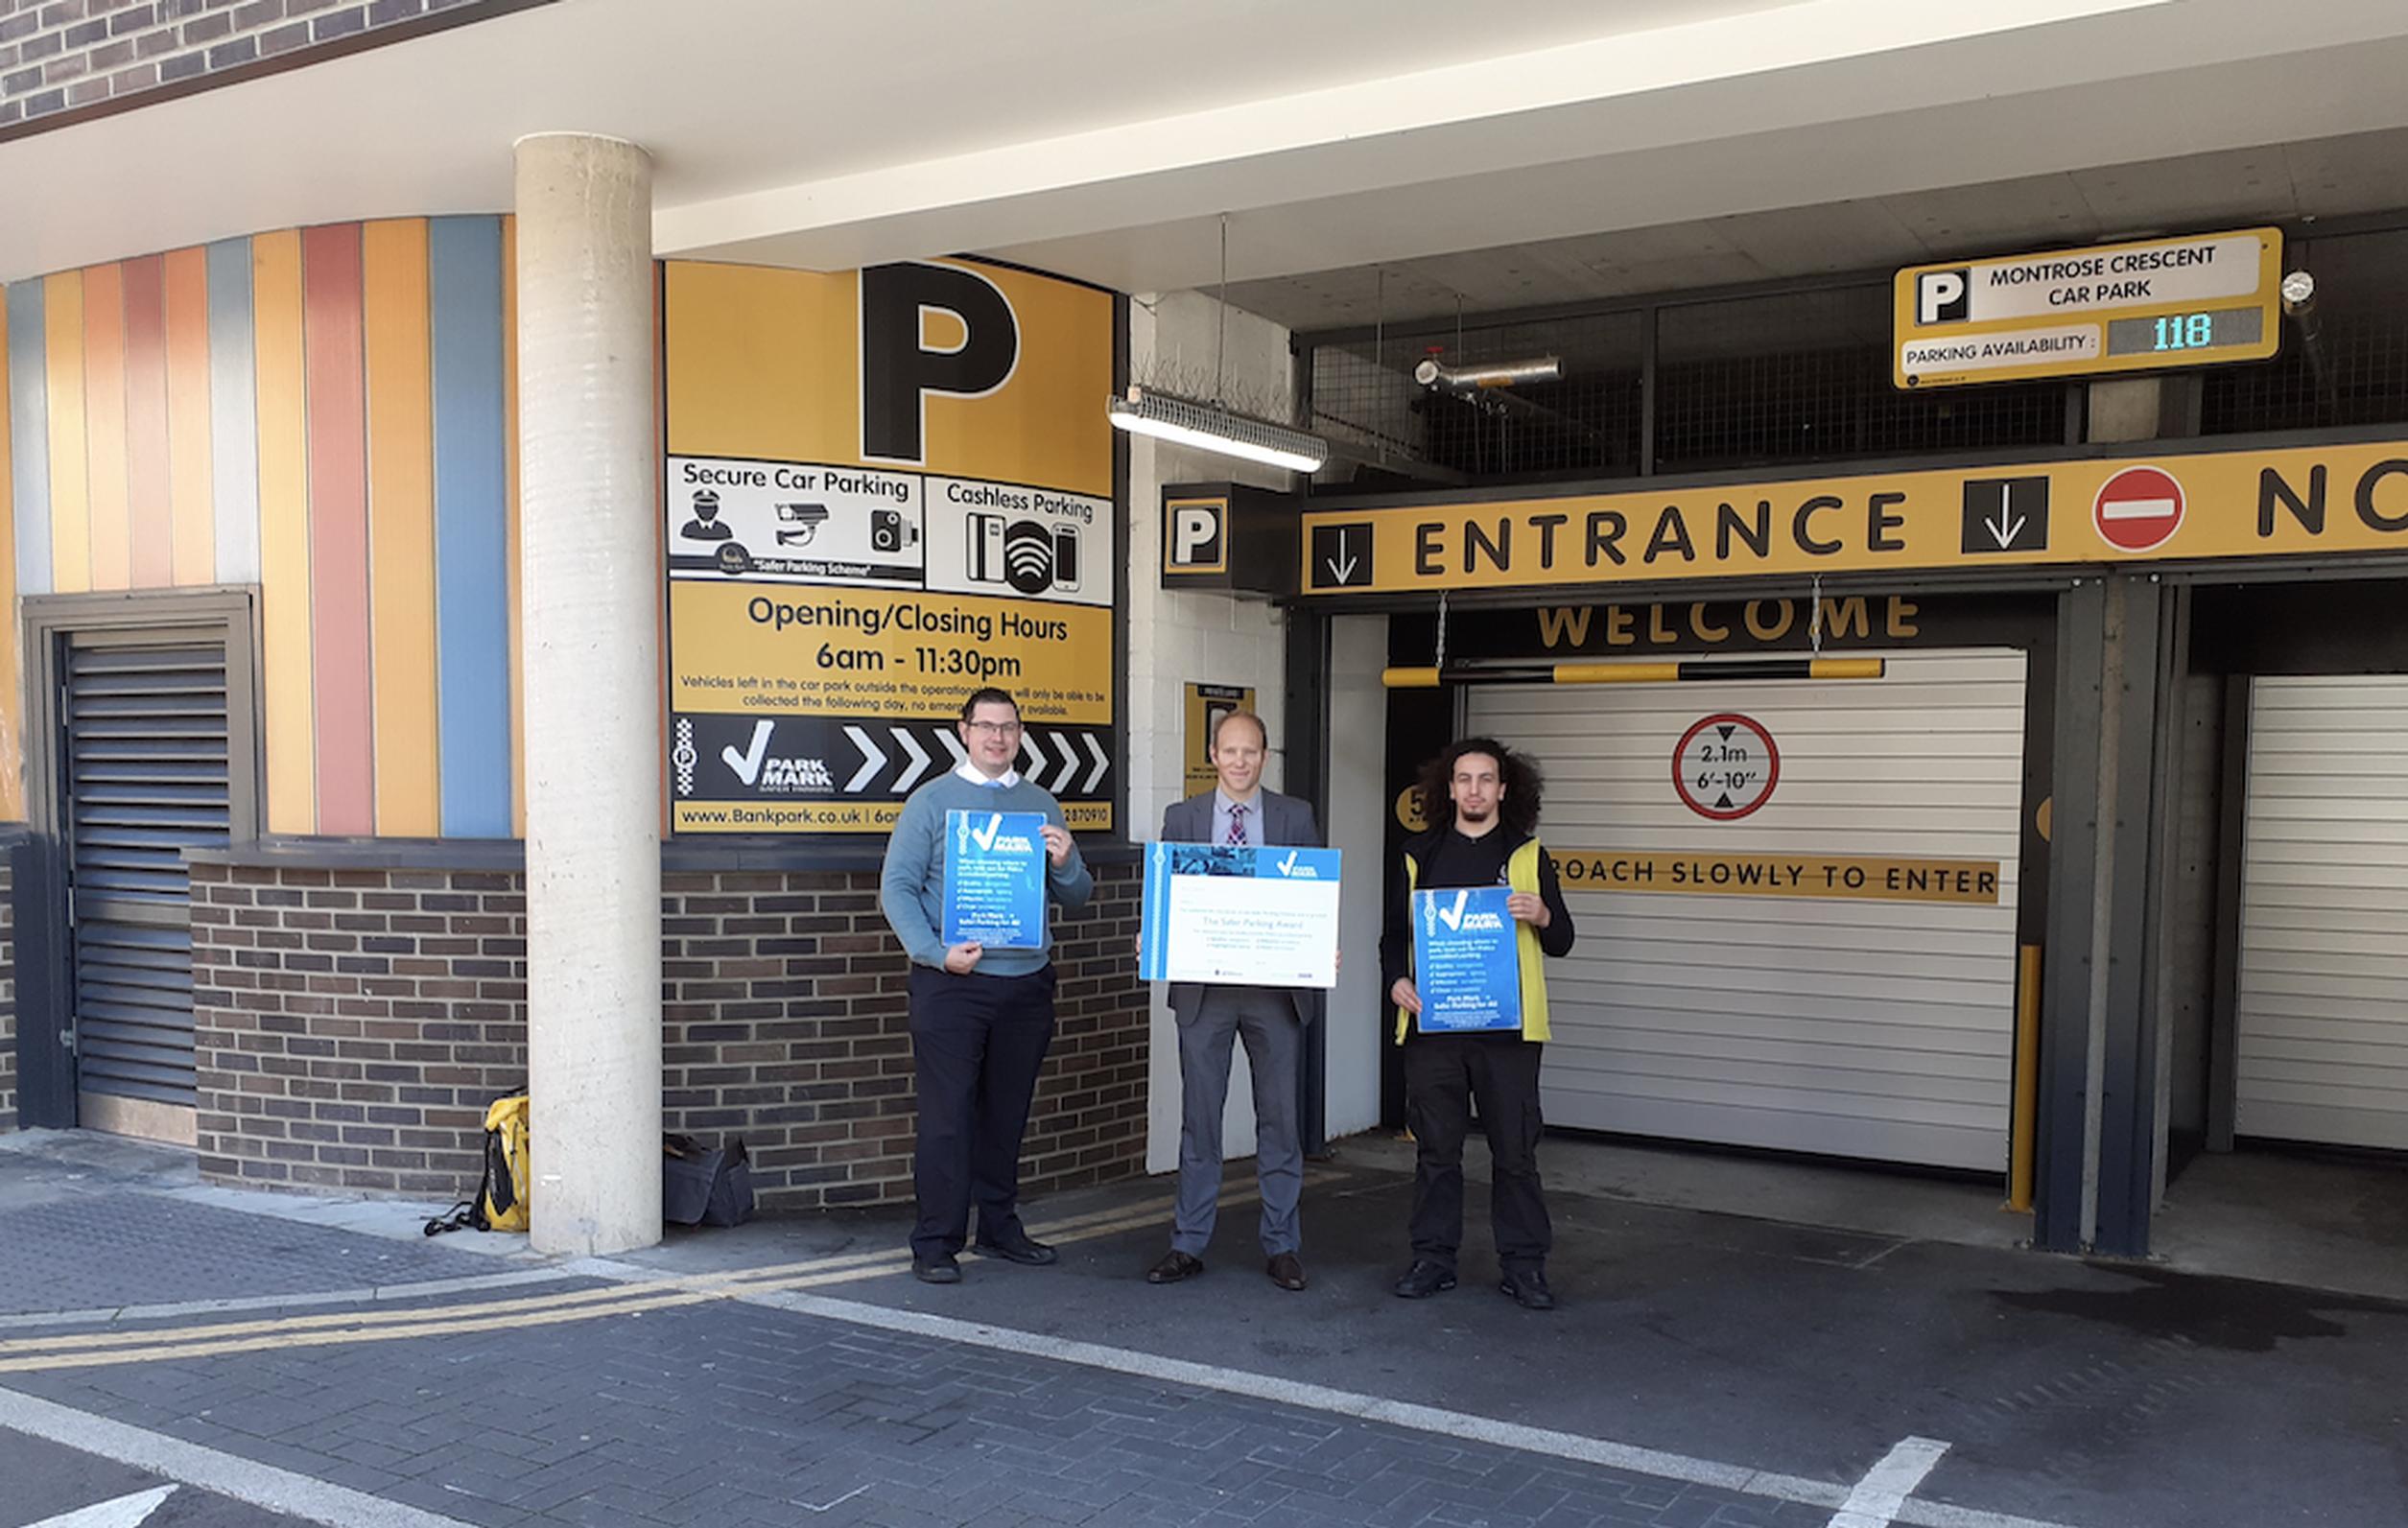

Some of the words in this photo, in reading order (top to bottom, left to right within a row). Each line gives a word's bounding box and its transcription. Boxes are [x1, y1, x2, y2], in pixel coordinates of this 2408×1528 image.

[1991, 256, 2104, 287] MONTROSE
[2111, 246, 2216, 272] CRESCENT
[1921, 273, 1965, 323] P
[2048, 285, 2089, 307] CAR
[2096, 280, 2151, 301] PARK
[2153, 314, 2211, 351] 118
[859, 260, 1021, 466] P
[1906, 344, 1976, 365] PARKING
[684, 462, 766, 487] Secure
[775, 468, 815, 490] Car
[825, 472, 909, 504] Parking
[947, 483, 1028, 510] Cashless
[1033, 494, 1094, 525] Parking
[1176, 509, 1216, 563] P
[1415, 492, 1905, 576] ENTRANCE
[788, 561, 825, 576] Parking
[748, 597, 991, 642] Opening/Closing
[1002, 612, 1068, 641] Hours
[1536, 596, 1919, 648] WELCOME
[816, 643, 884, 670] 6am
[915, 647, 1021, 681] 11:30pm
[680, 675, 734, 689] Vehicles
[737, 675, 757, 689] left
[762, 676, 772, 689] in
[776, 676, 797, 690] the
[800, 679, 820, 691] car
[823, 679, 850, 693] park
[855, 680, 896, 693] outside
[900, 682, 917, 694] the
[1015, 686, 1031, 698] will
[1032, 688, 1051, 701] only
[1052, 688, 1064, 701] be
[743, 693, 799, 707] collected
[802, 694, 821, 708] the
[825, 694, 881, 712] following
[911, 700, 926, 712] no
[767, 758, 825, 772] PARK
[1701, 744, 1748, 763] 2.1m
[762, 771, 833, 786] MARK
[682, 808, 861, 827] www.Bankpark.co.uk
[1672, 862, 1804, 886] SLOWLY
[1823, 865, 1865, 888] TO
[1886, 868, 1995, 894] ENTER
